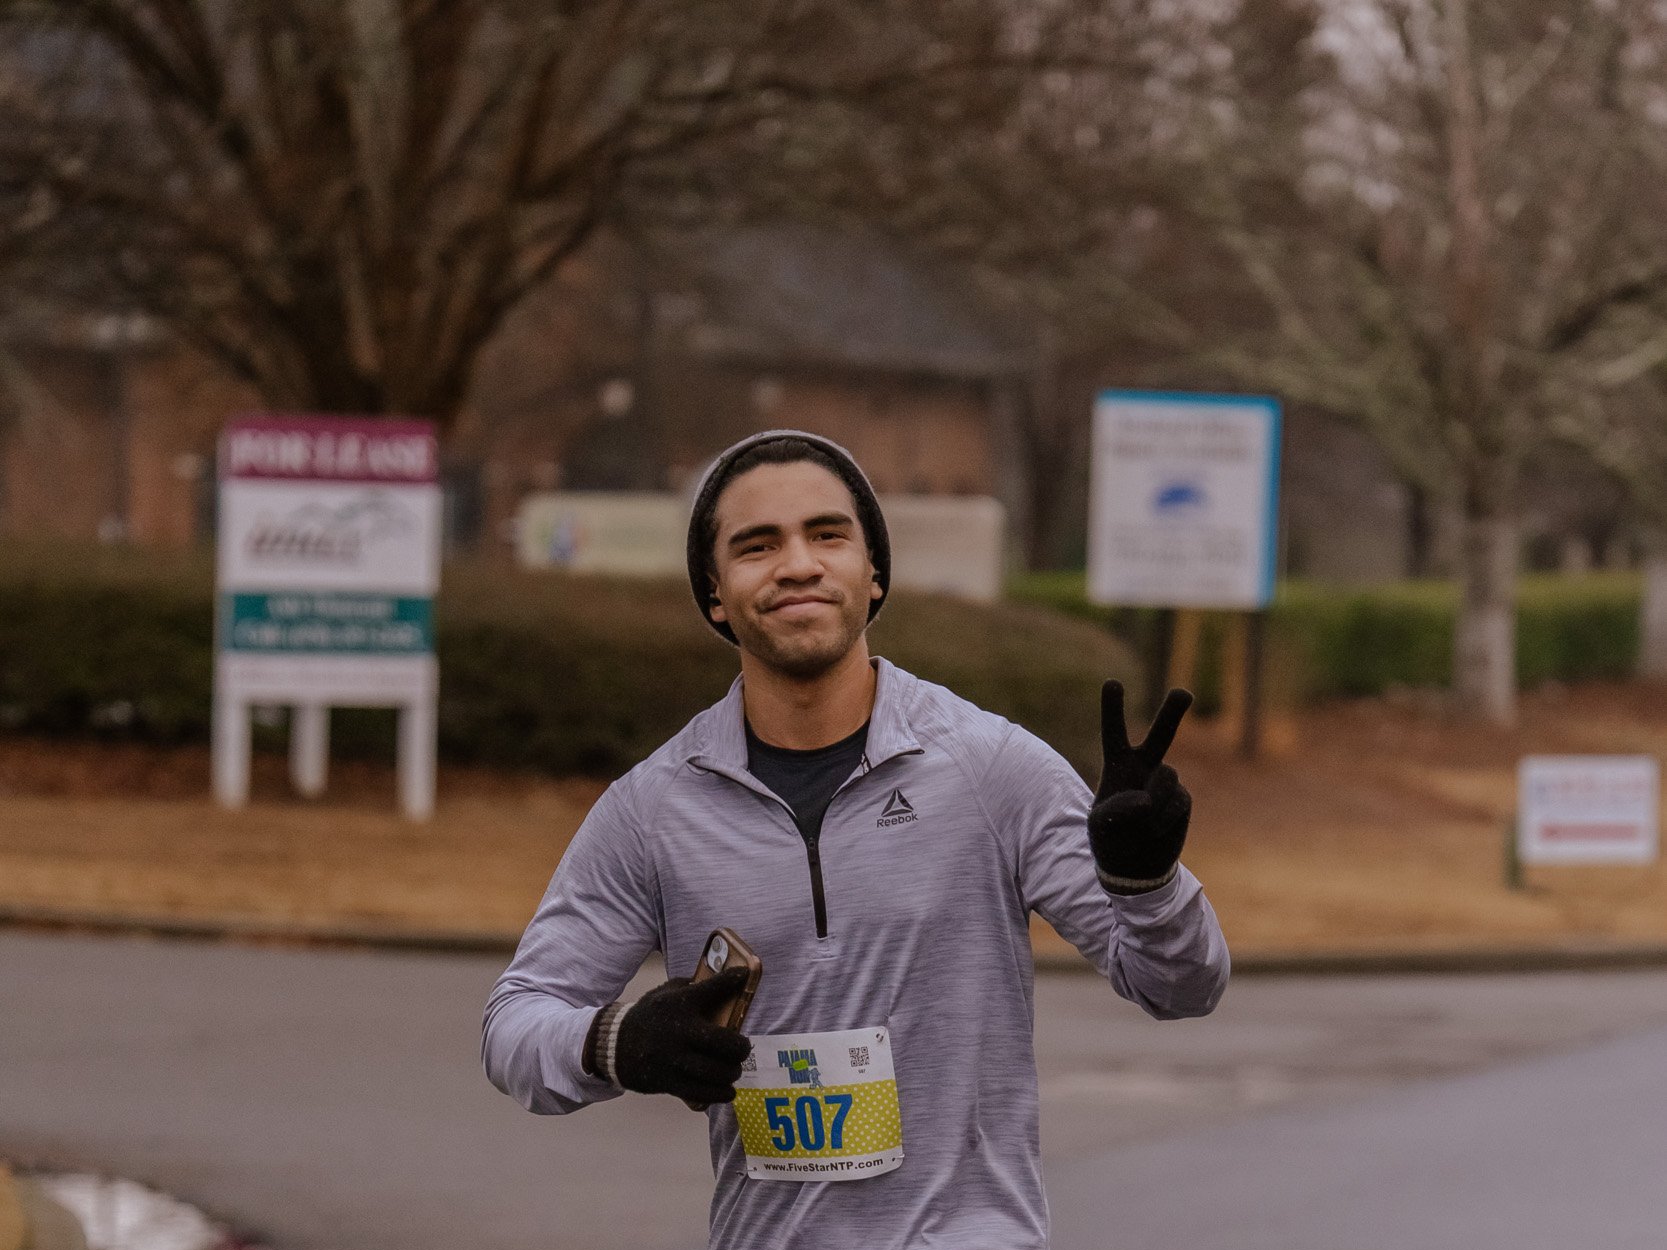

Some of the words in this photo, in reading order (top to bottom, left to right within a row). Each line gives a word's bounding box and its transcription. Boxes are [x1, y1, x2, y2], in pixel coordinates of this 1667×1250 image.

[876, 813, 919, 828] Reebok
[765, 1093, 853, 1152] 507
[764, 1157, 884, 1172] www.FiveStarNTP.com
